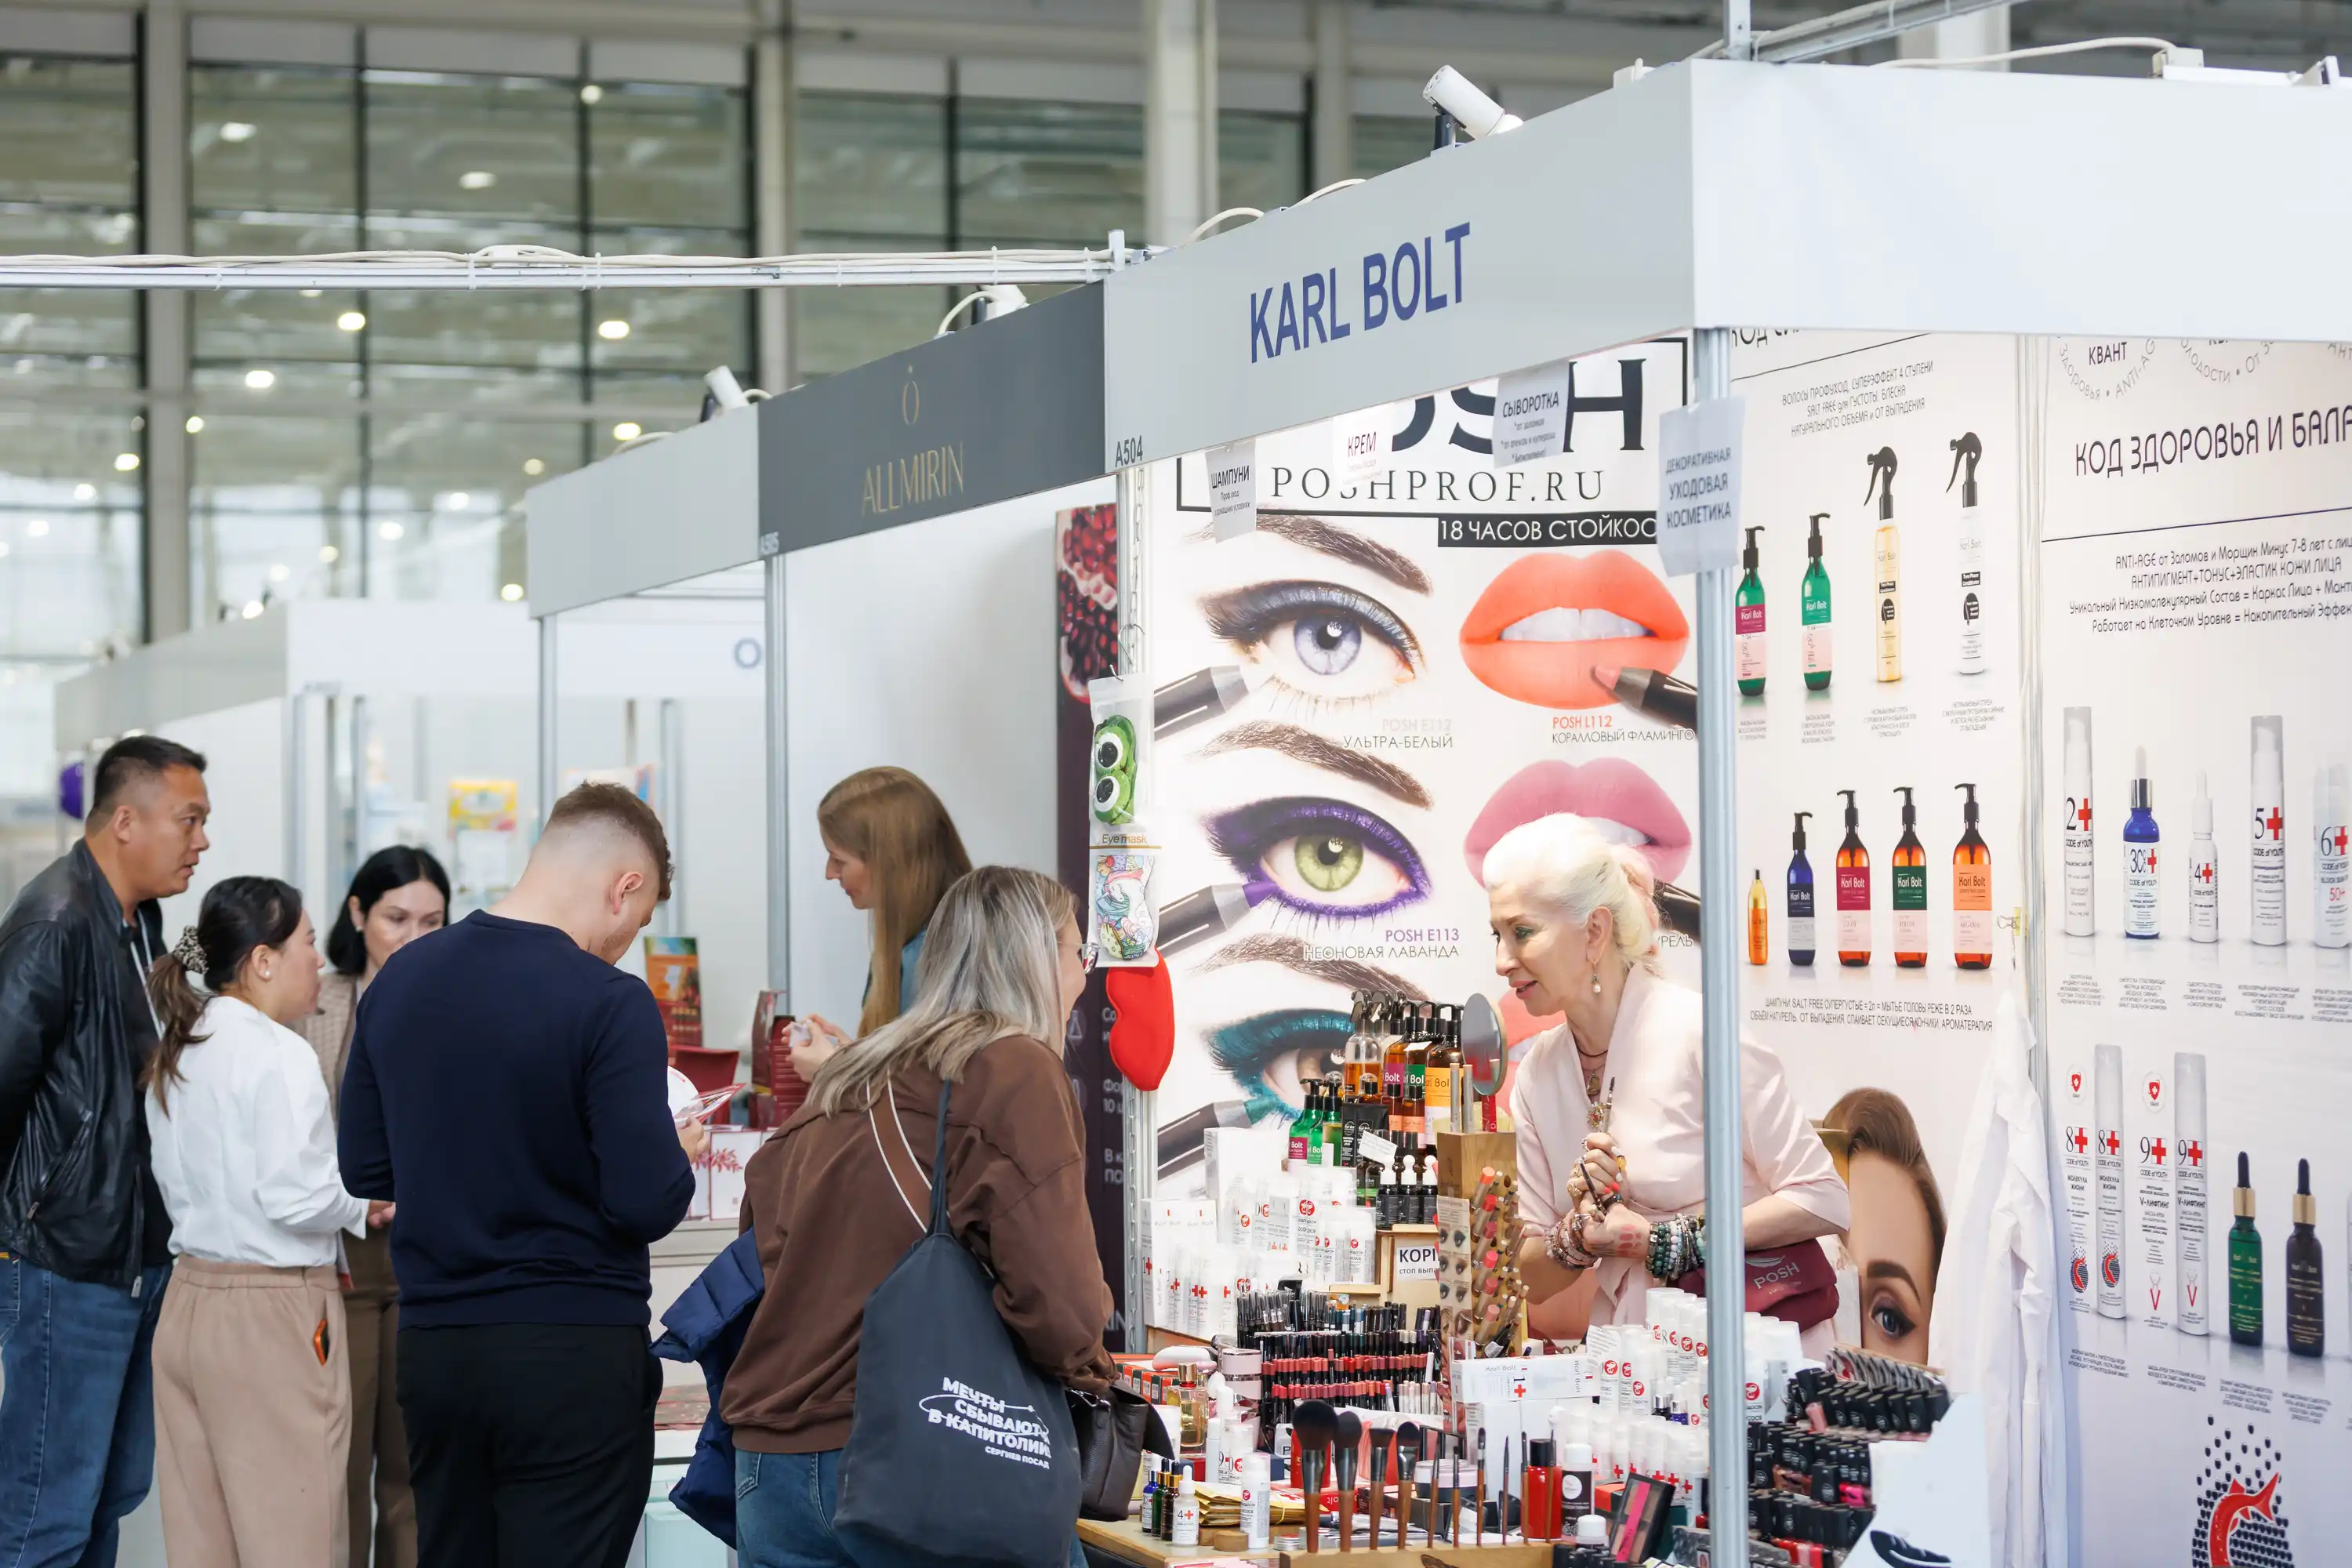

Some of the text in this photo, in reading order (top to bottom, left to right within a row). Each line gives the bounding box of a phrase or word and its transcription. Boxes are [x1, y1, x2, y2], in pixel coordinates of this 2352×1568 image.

[1250, 221, 1471, 363] KARL BOLT
[2089, 341, 2127, 365] КВАНТ
[1503, 390, 1559, 418] СЫВОРОТКА
[1115, 435, 1143, 466] A504
[1348, 431, 1377, 458] КРЕМ
[2076, 438, 2124, 477] КОД
[2131, 419, 2259, 474] ЗДОРОВЬЯ
[2268, 415, 2282, 452] И
[1666, 448, 1732, 474] ДЕКОРАТИВНАЯ
[863, 441, 964, 517] ALLMIRIN
[1210, 465, 1250, 488] ШАМПУНИ
[1669, 473, 1729, 500] УХОДОВАЯ
[1666, 505, 1731, 529] КОСМЕТИКА
[1441, 519, 1464, 540] 18
[1468, 518, 1542, 541] ЧАСОВ
[2116, 552, 2156, 570] ANTI-AGE
[2158, 554, 2169, 566] от
[2171, 550, 2209, 564] Заломов
[2219, 545, 2258, 564] Морщин
[2260, 542, 2289, 557] Минус
[2292, 538, 2307, 554] 7-8
[2308, 539, 2325, 553] лет
[2280, 558, 2311, 576] КОЖИ
[2314, 556, 2343, 574] ЛИЦА
[2070, 597, 2117, 615] Уникальный
[2119, 590, 2208, 612] Низкомолекулярный
[2209, 589, 2241, 604] Состав
[2252, 585, 2286, 602] Каркас
[2288, 583, 2313, 599] Лица
[2092, 619, 2133, 633] Работает
[2136, 619, 2147, 630] на
[2149, 615, 2195, 630] Клеточном
[2198, 612, 2232, 628] Уровне
[2244, 603, 2315, 622] Накопительный
[1382, 718, 1452, 732] POSH E112
[1552, 715, 1612, 730] POSH L112
[1343, 733, 1453, 749] УЛЬТРА-БЕЛЫЙ
[1552, 727, 1694, 744] КОРАЛЛОВЫЙ ФЛАМИНГО
[1102, 833, 1147, 845] Eye mask
[1841, 877, 1865, 887] Karl Bolt
[1898, 876, 1922, 887] Karl Bolt
[1959, 875, 1985, 887] Karl Bolt
[1790, 891, 1811, 901] Karl Bolt
[1385, 927, 1459, 943] POSH E113
[1304, 943, 1459, 960] НЕОНОВАЯ ЛАВАНДА
[1792, 998, 1808, 1009] SALT
[1809, 999, 1824, 1009] FREE
[1956, 1004, 1973, 1015] РАЗА
[1941, 1018, 1993, 1032] АРОМАТЕРАПИЯ
[1385, 1073, 1400, 1082] Bolt
[1753, 1261, 1800, 1290] POSH
[942, 1377, 1005, 1414] МЕЧТЫ
[928, 1409, 942, 1424] В
[985, 1446, 1050, 1470] СЕРГИЕВ ПОСАД
